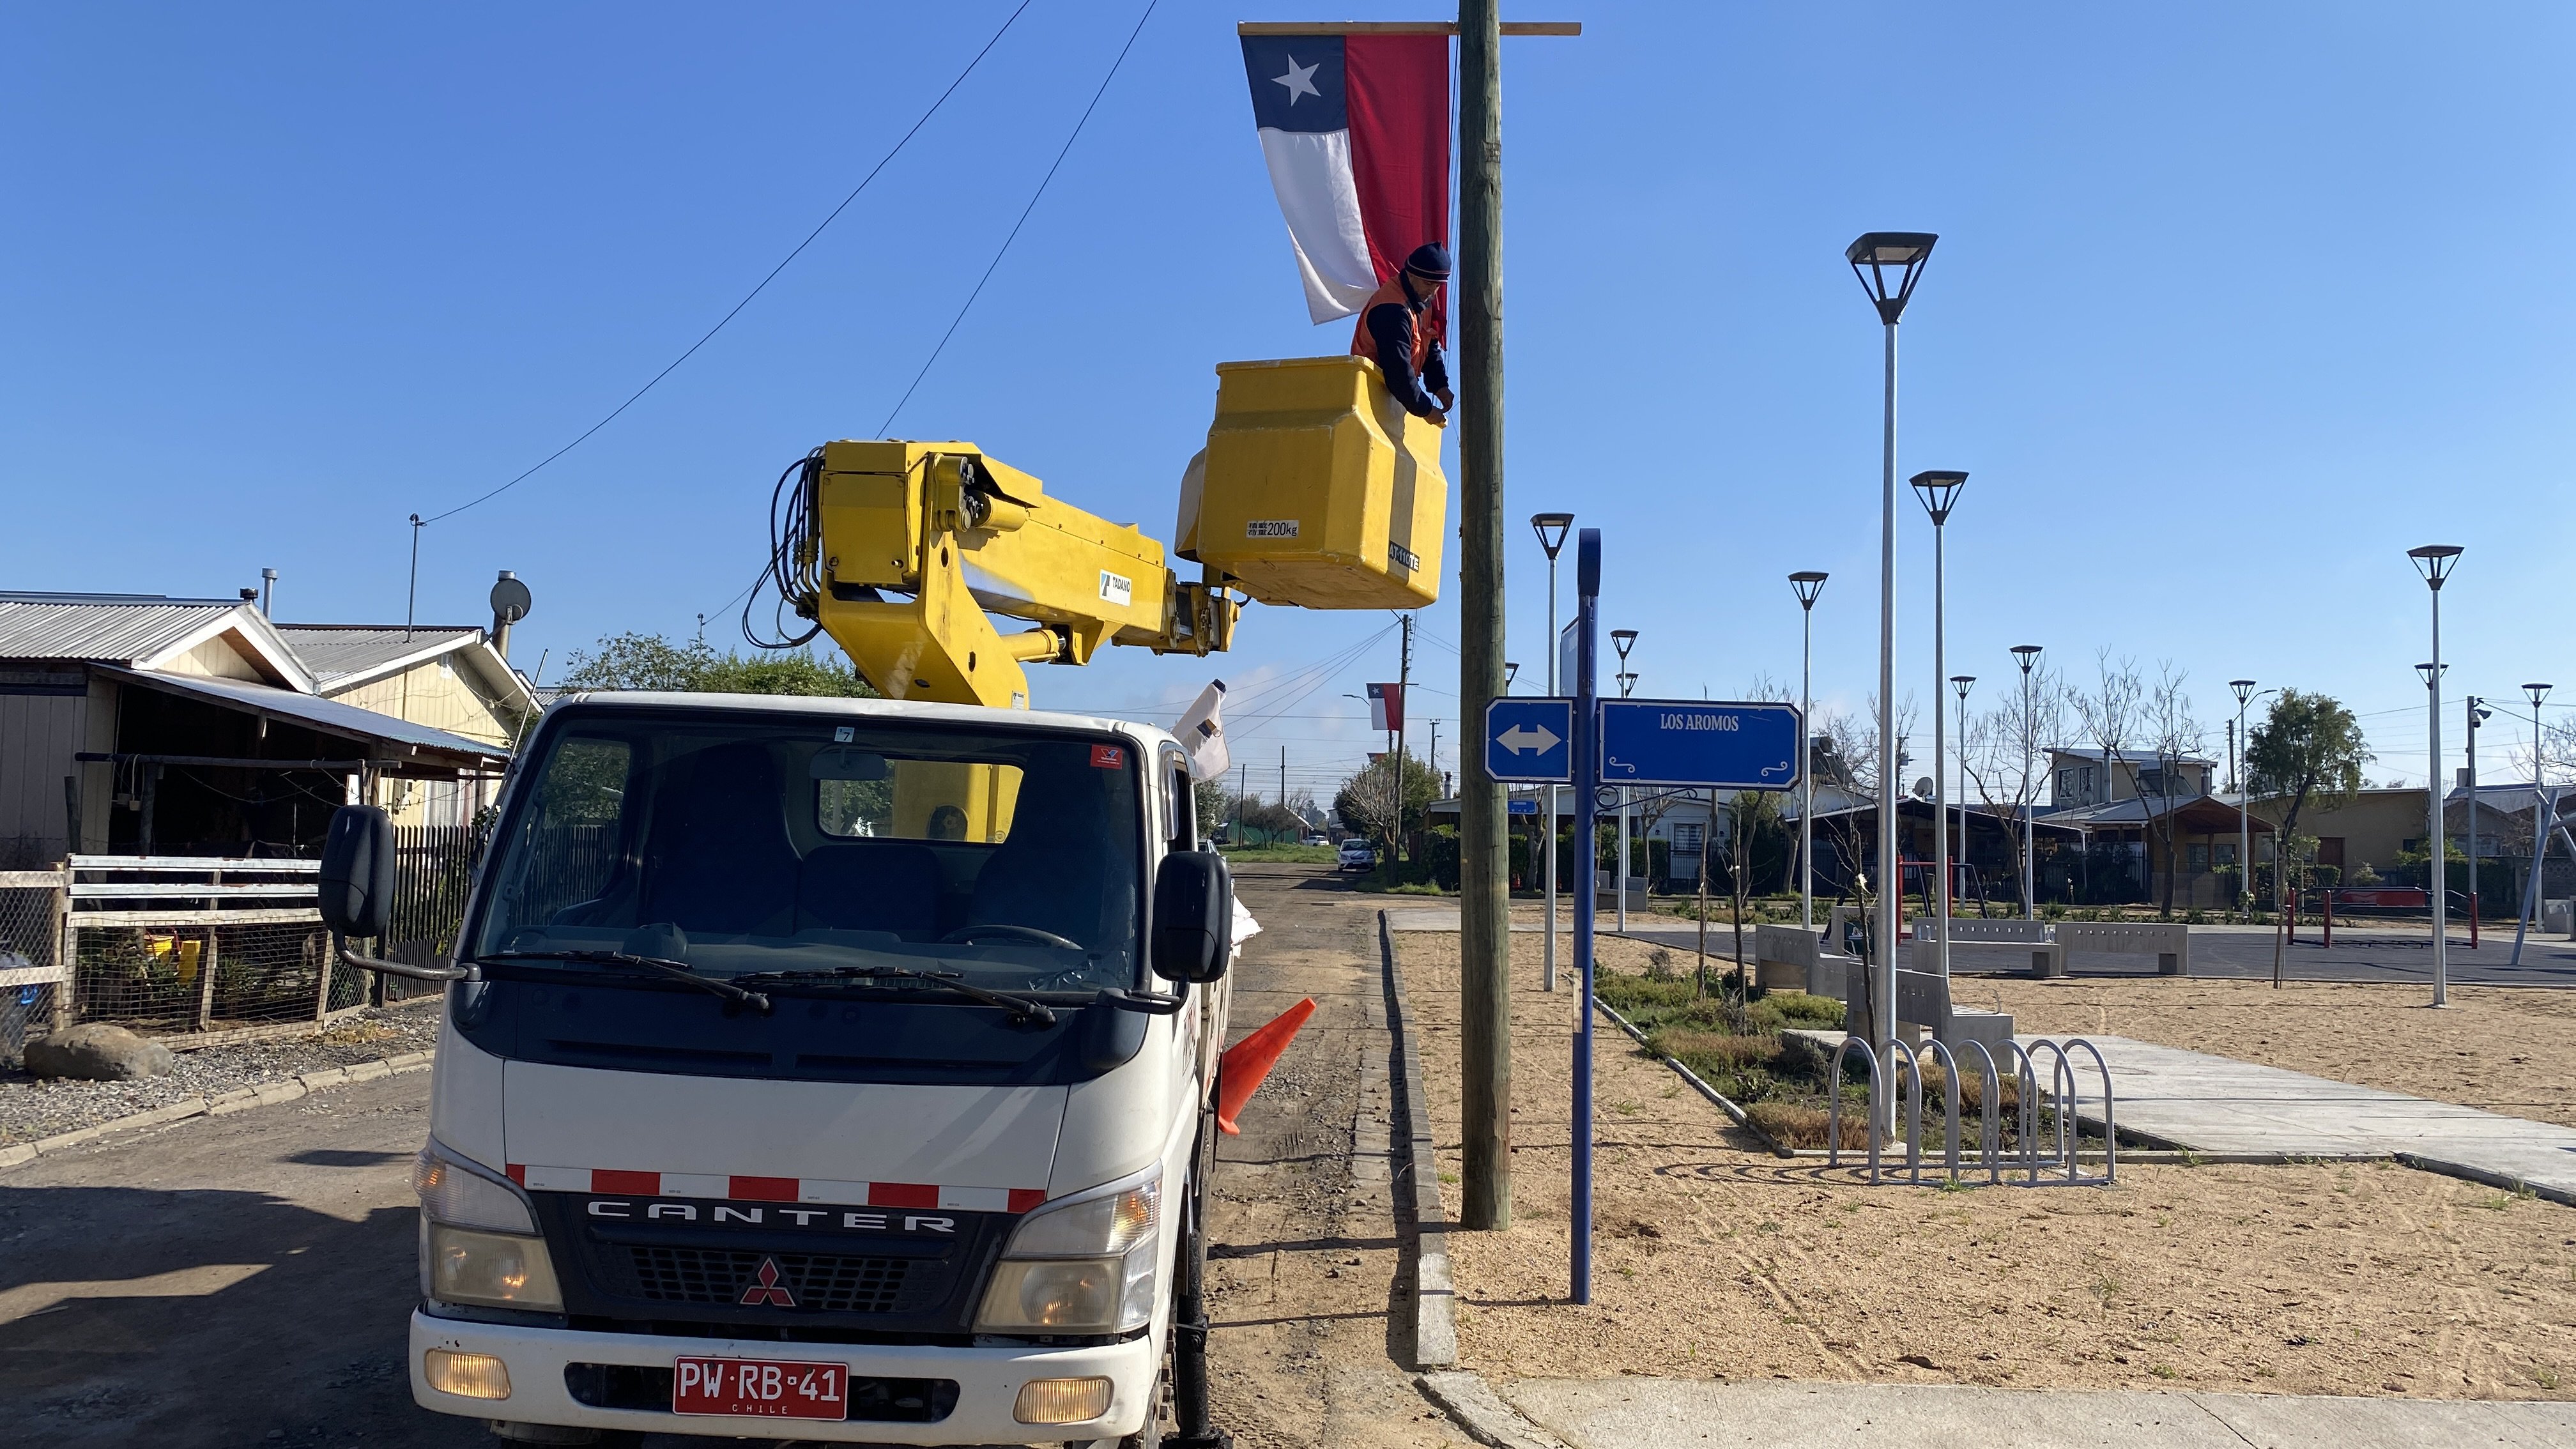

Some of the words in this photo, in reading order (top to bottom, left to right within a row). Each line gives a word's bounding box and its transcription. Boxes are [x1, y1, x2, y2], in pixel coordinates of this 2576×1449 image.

[1267, 522, 1298, 536] 200kg
[1112, 576, 1130, 593] TADANO
[1660, 714, 1683, 730] LOS
[1685, 714, 1739, 731] AROMOS
[843, 732, 850, 741] 7
[588, 1201, 955, 1232] CANTER
[732, 1404, 787, 1414] CHILE
